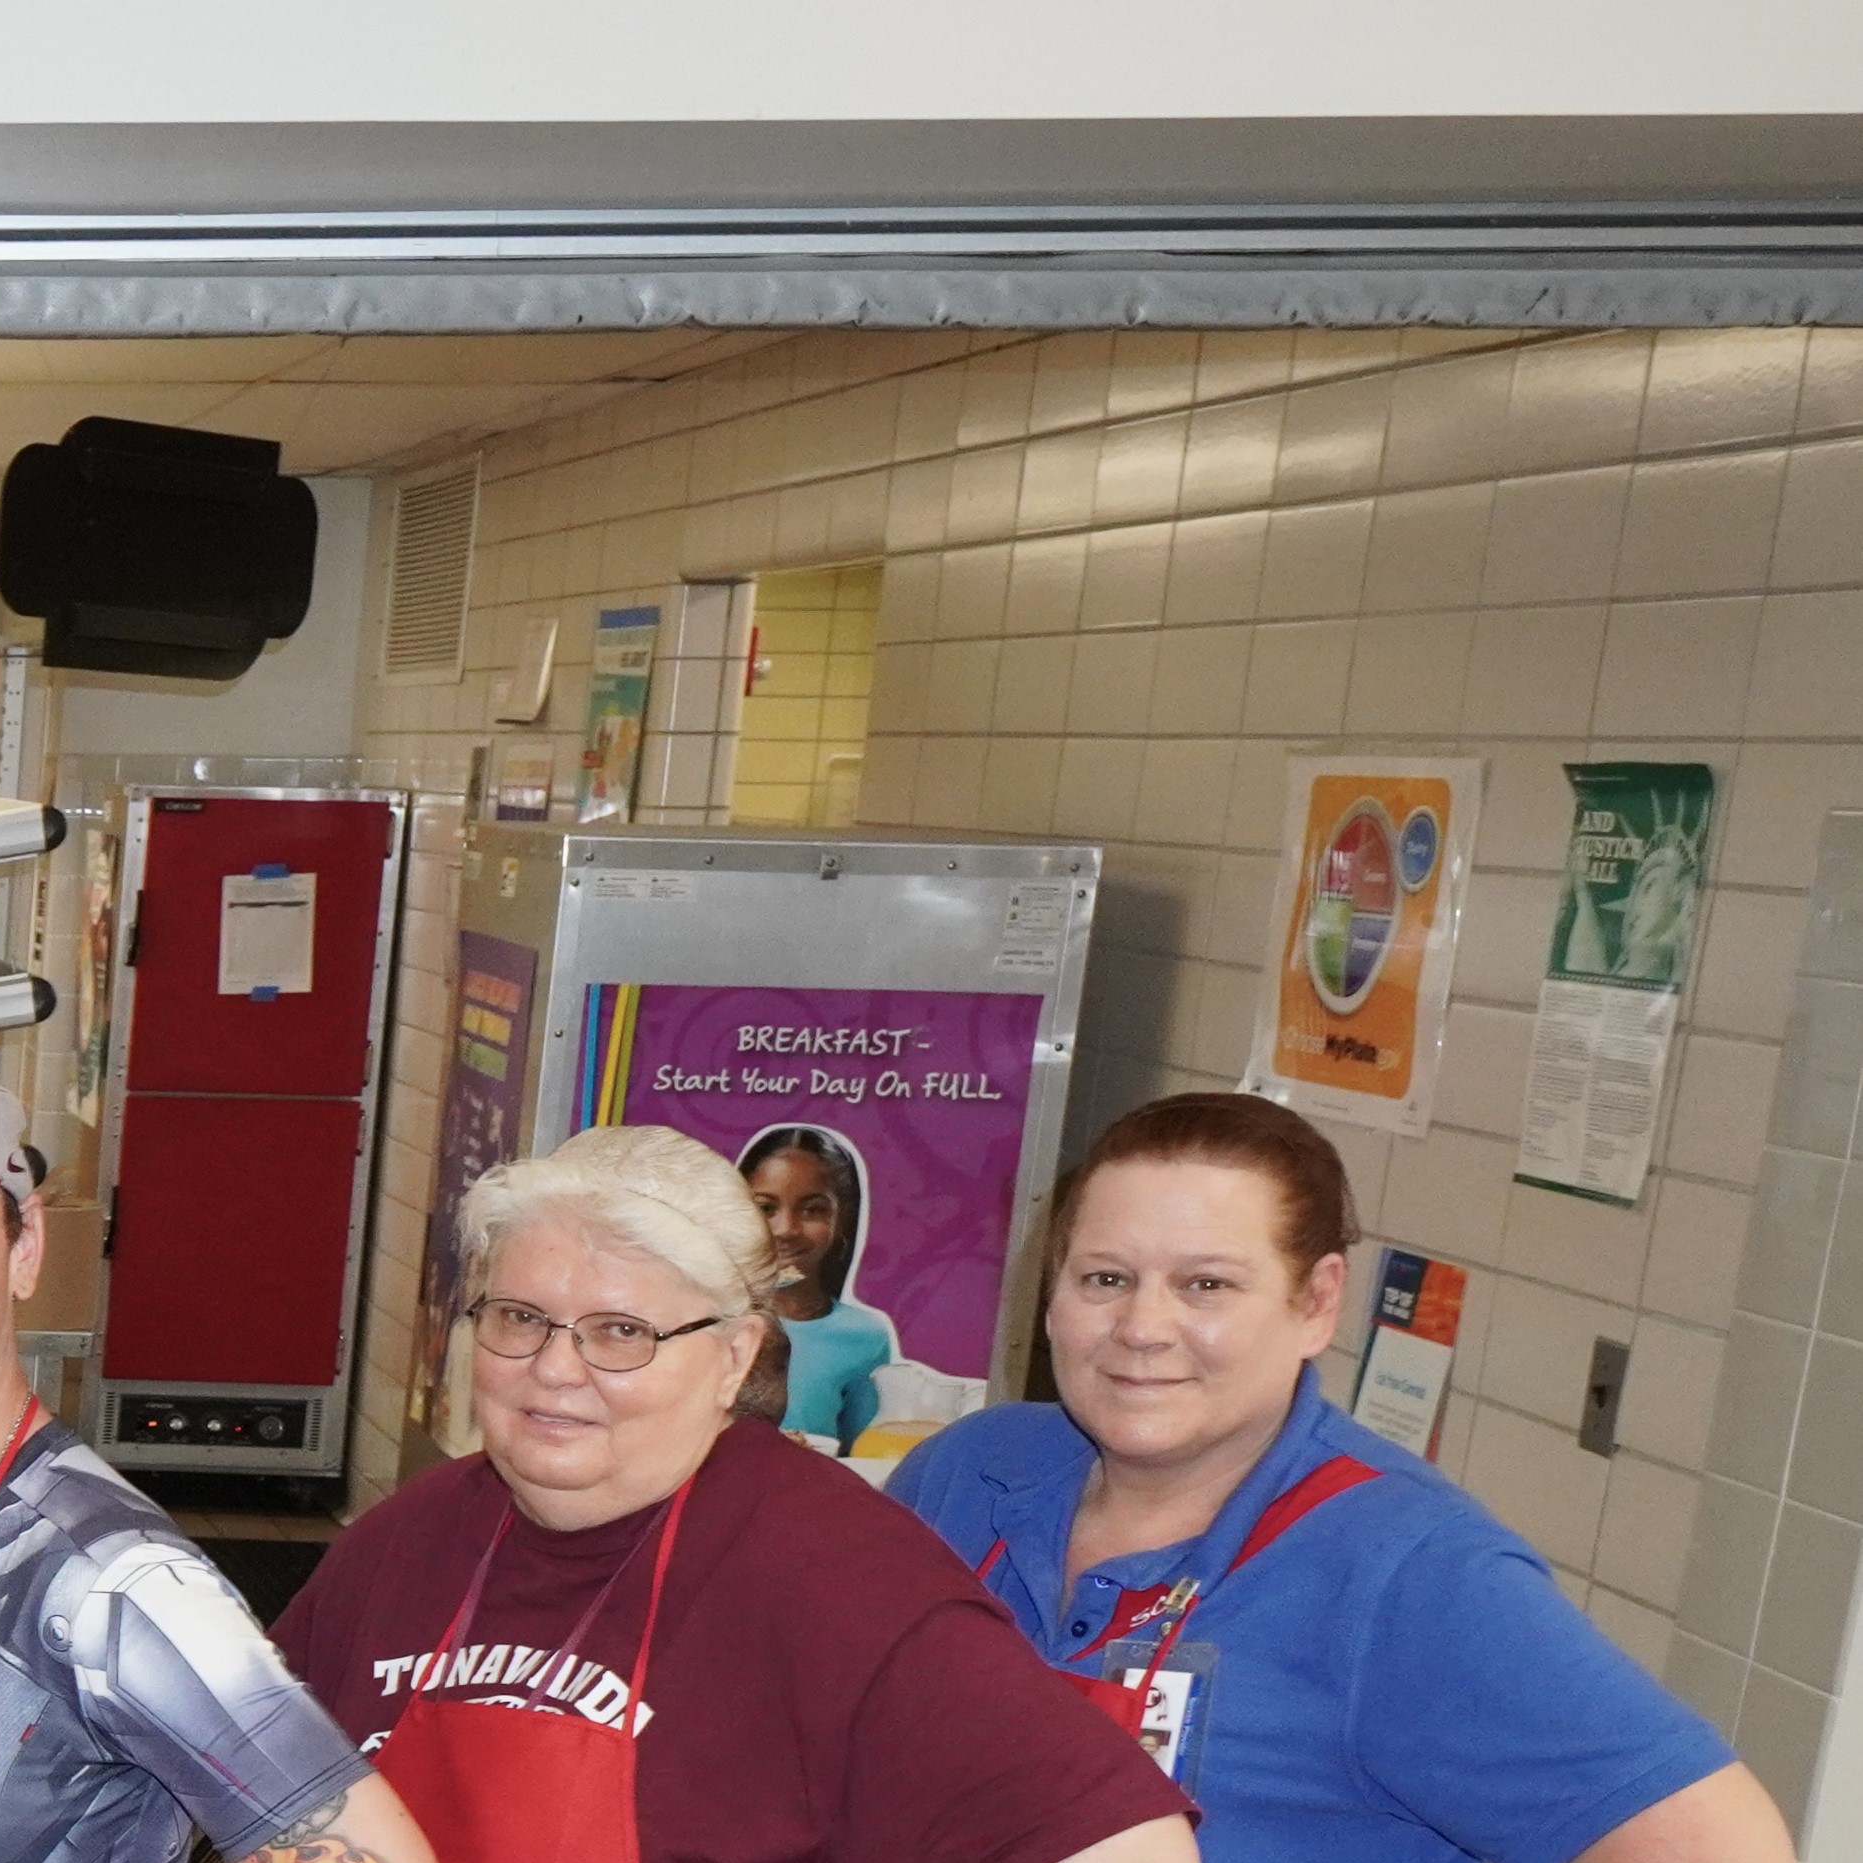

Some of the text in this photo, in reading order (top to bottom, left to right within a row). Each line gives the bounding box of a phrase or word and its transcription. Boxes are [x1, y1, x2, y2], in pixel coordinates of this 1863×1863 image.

[736, 1025, 913, 1056] BREAKFAST
[653, 1065, 1002, 1101] Start Your Day On FULL.
[373, 1644, 656, 1739] TONAWANDA
